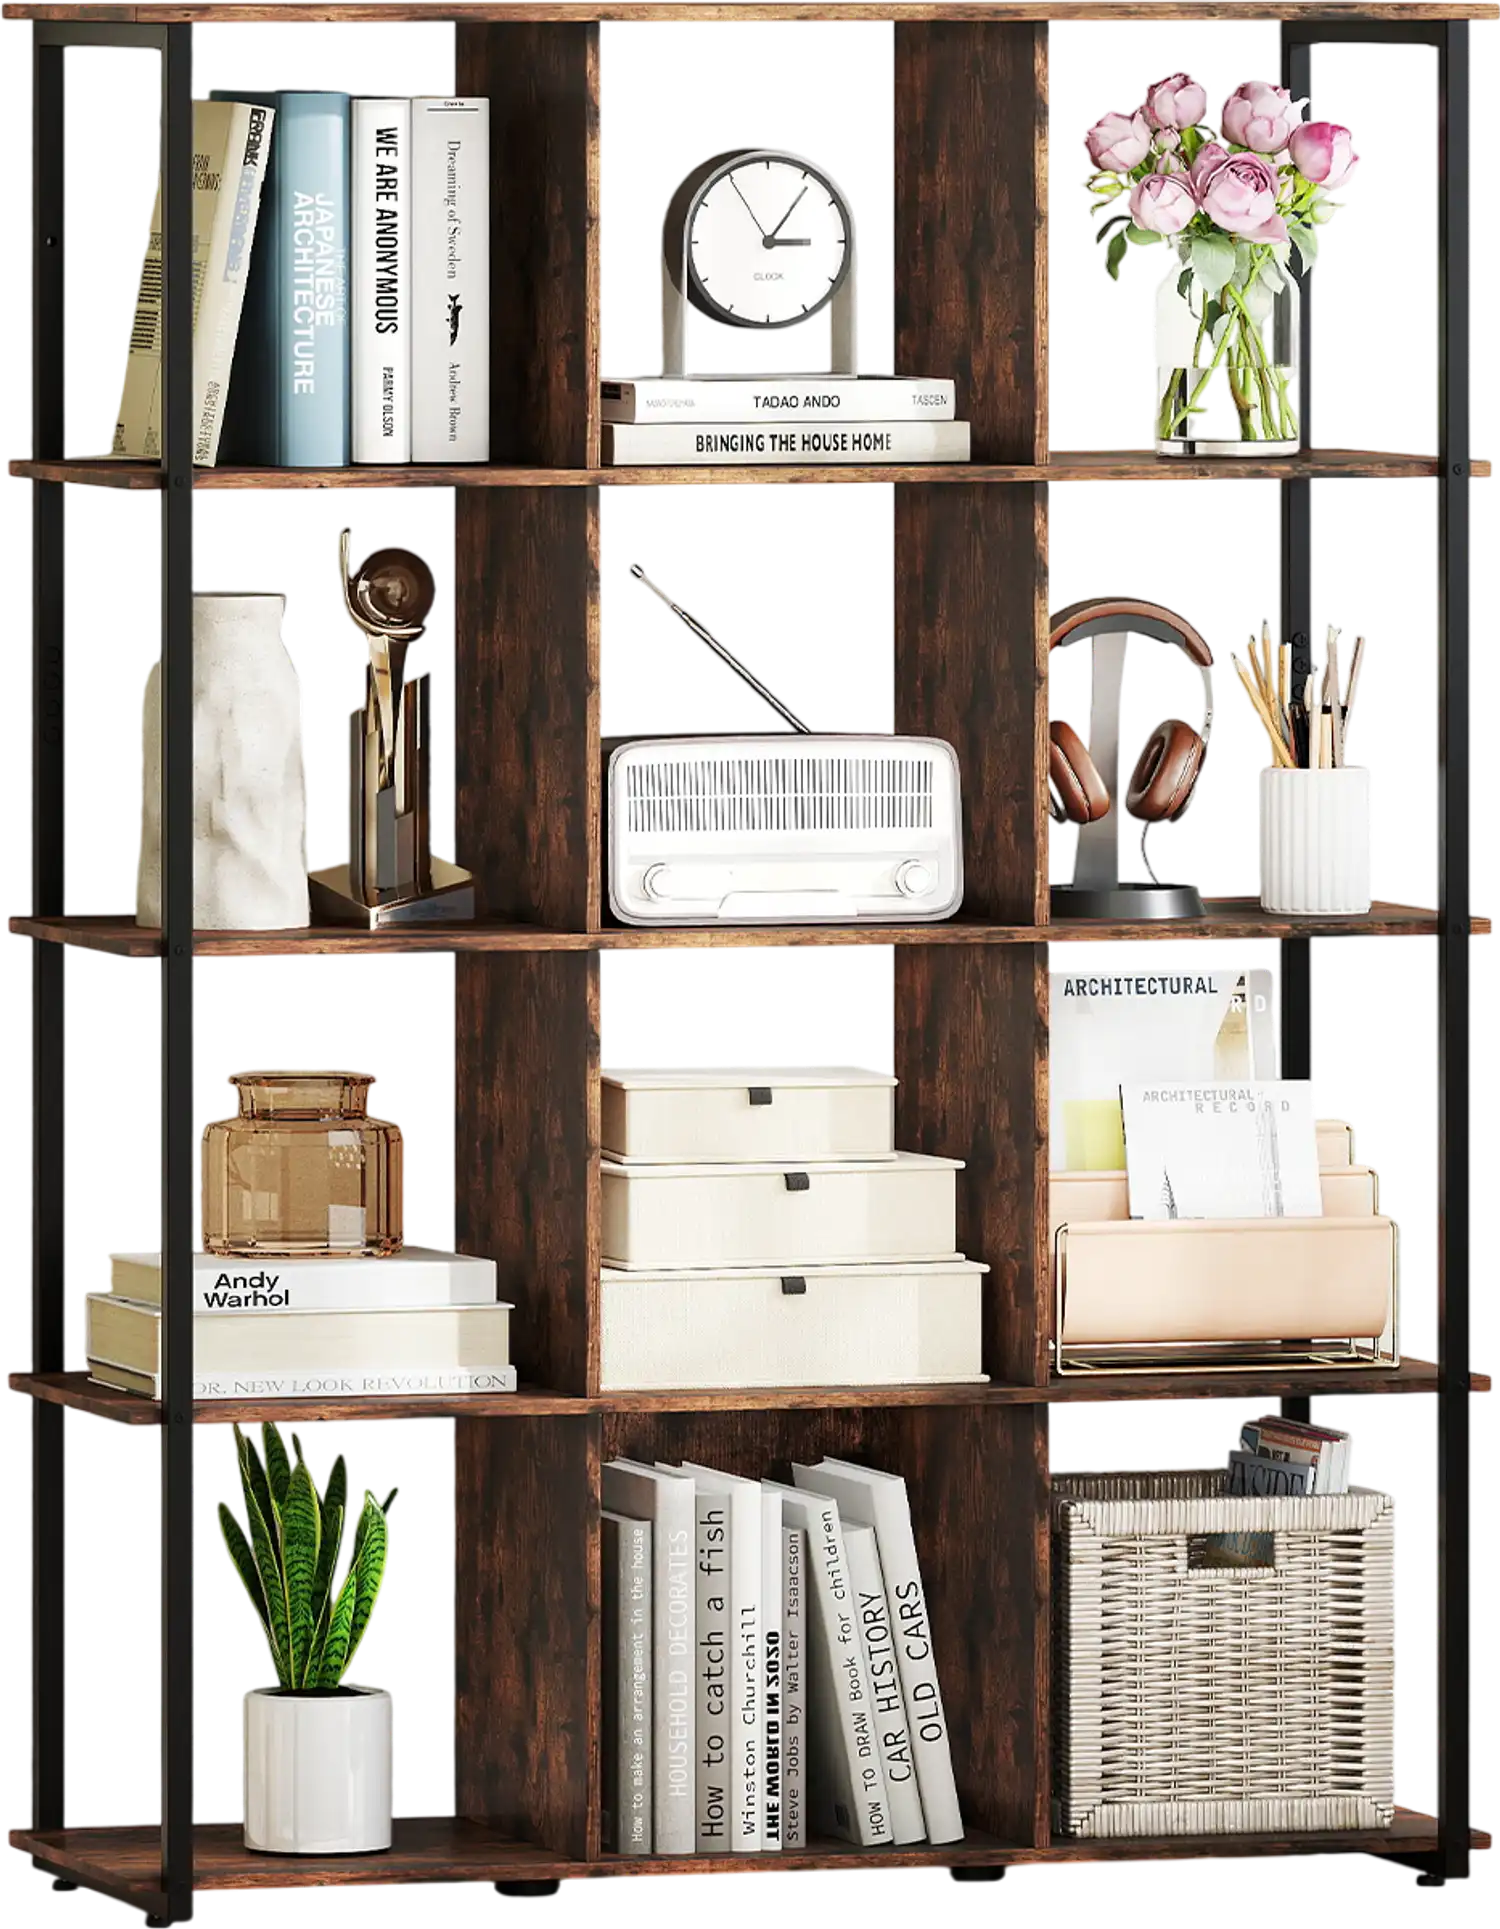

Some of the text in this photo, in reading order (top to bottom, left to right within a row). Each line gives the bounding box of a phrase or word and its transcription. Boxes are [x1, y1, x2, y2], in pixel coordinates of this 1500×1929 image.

[315, 193, 335, 326] JAPANESE
[375, 127, 398, 334] WE ARE ANONYMOUS
[444, 140, 461, 280] Dreaming of Sweden
[753, 272, 784, 281] CLOCK
[294, 191, 314, 394] ARCHITECTURE
[383, 404, 394, 437] OLSON
[449, 362, 461, 442] Andrew Brown
[696, 433, 892, 453] BRINGING THE HOUSE HOME
[753, 395, 841, 409] TADAO ANDO
[1064, 976, 1218, 997] ARCHITECTURAL
[1143, 1089, 1254, 1102] ARCHITECTURAL
[203, 1289, 289, 1308] Warhol
[214, 1271, 280, 1293] Andy
[234, 1379, 285, 1394] NEW
[292, 1377, 352, 1393] LOOK
[362, 1373, 508, 1391] REVOLUTION
[631, 1529, 646, 1842] How to make an arrangement in the house
[669, 1530, 687, 1797] HOUSEHOLD DECORATES
[700, 1510, 724, 1837] How to catch a fish
[741, 1604, 756, 1836] Winston Churchill
[786, 1533, 801, 1842] Steve Jobs by Walter Isaacson
[821, 1511, 885, 1836] HOW TO DRAW Book for children
[858, 1592, 911, 1783] CAR HISTORY
[895, 1581, 943, 1743] OLD CARS
